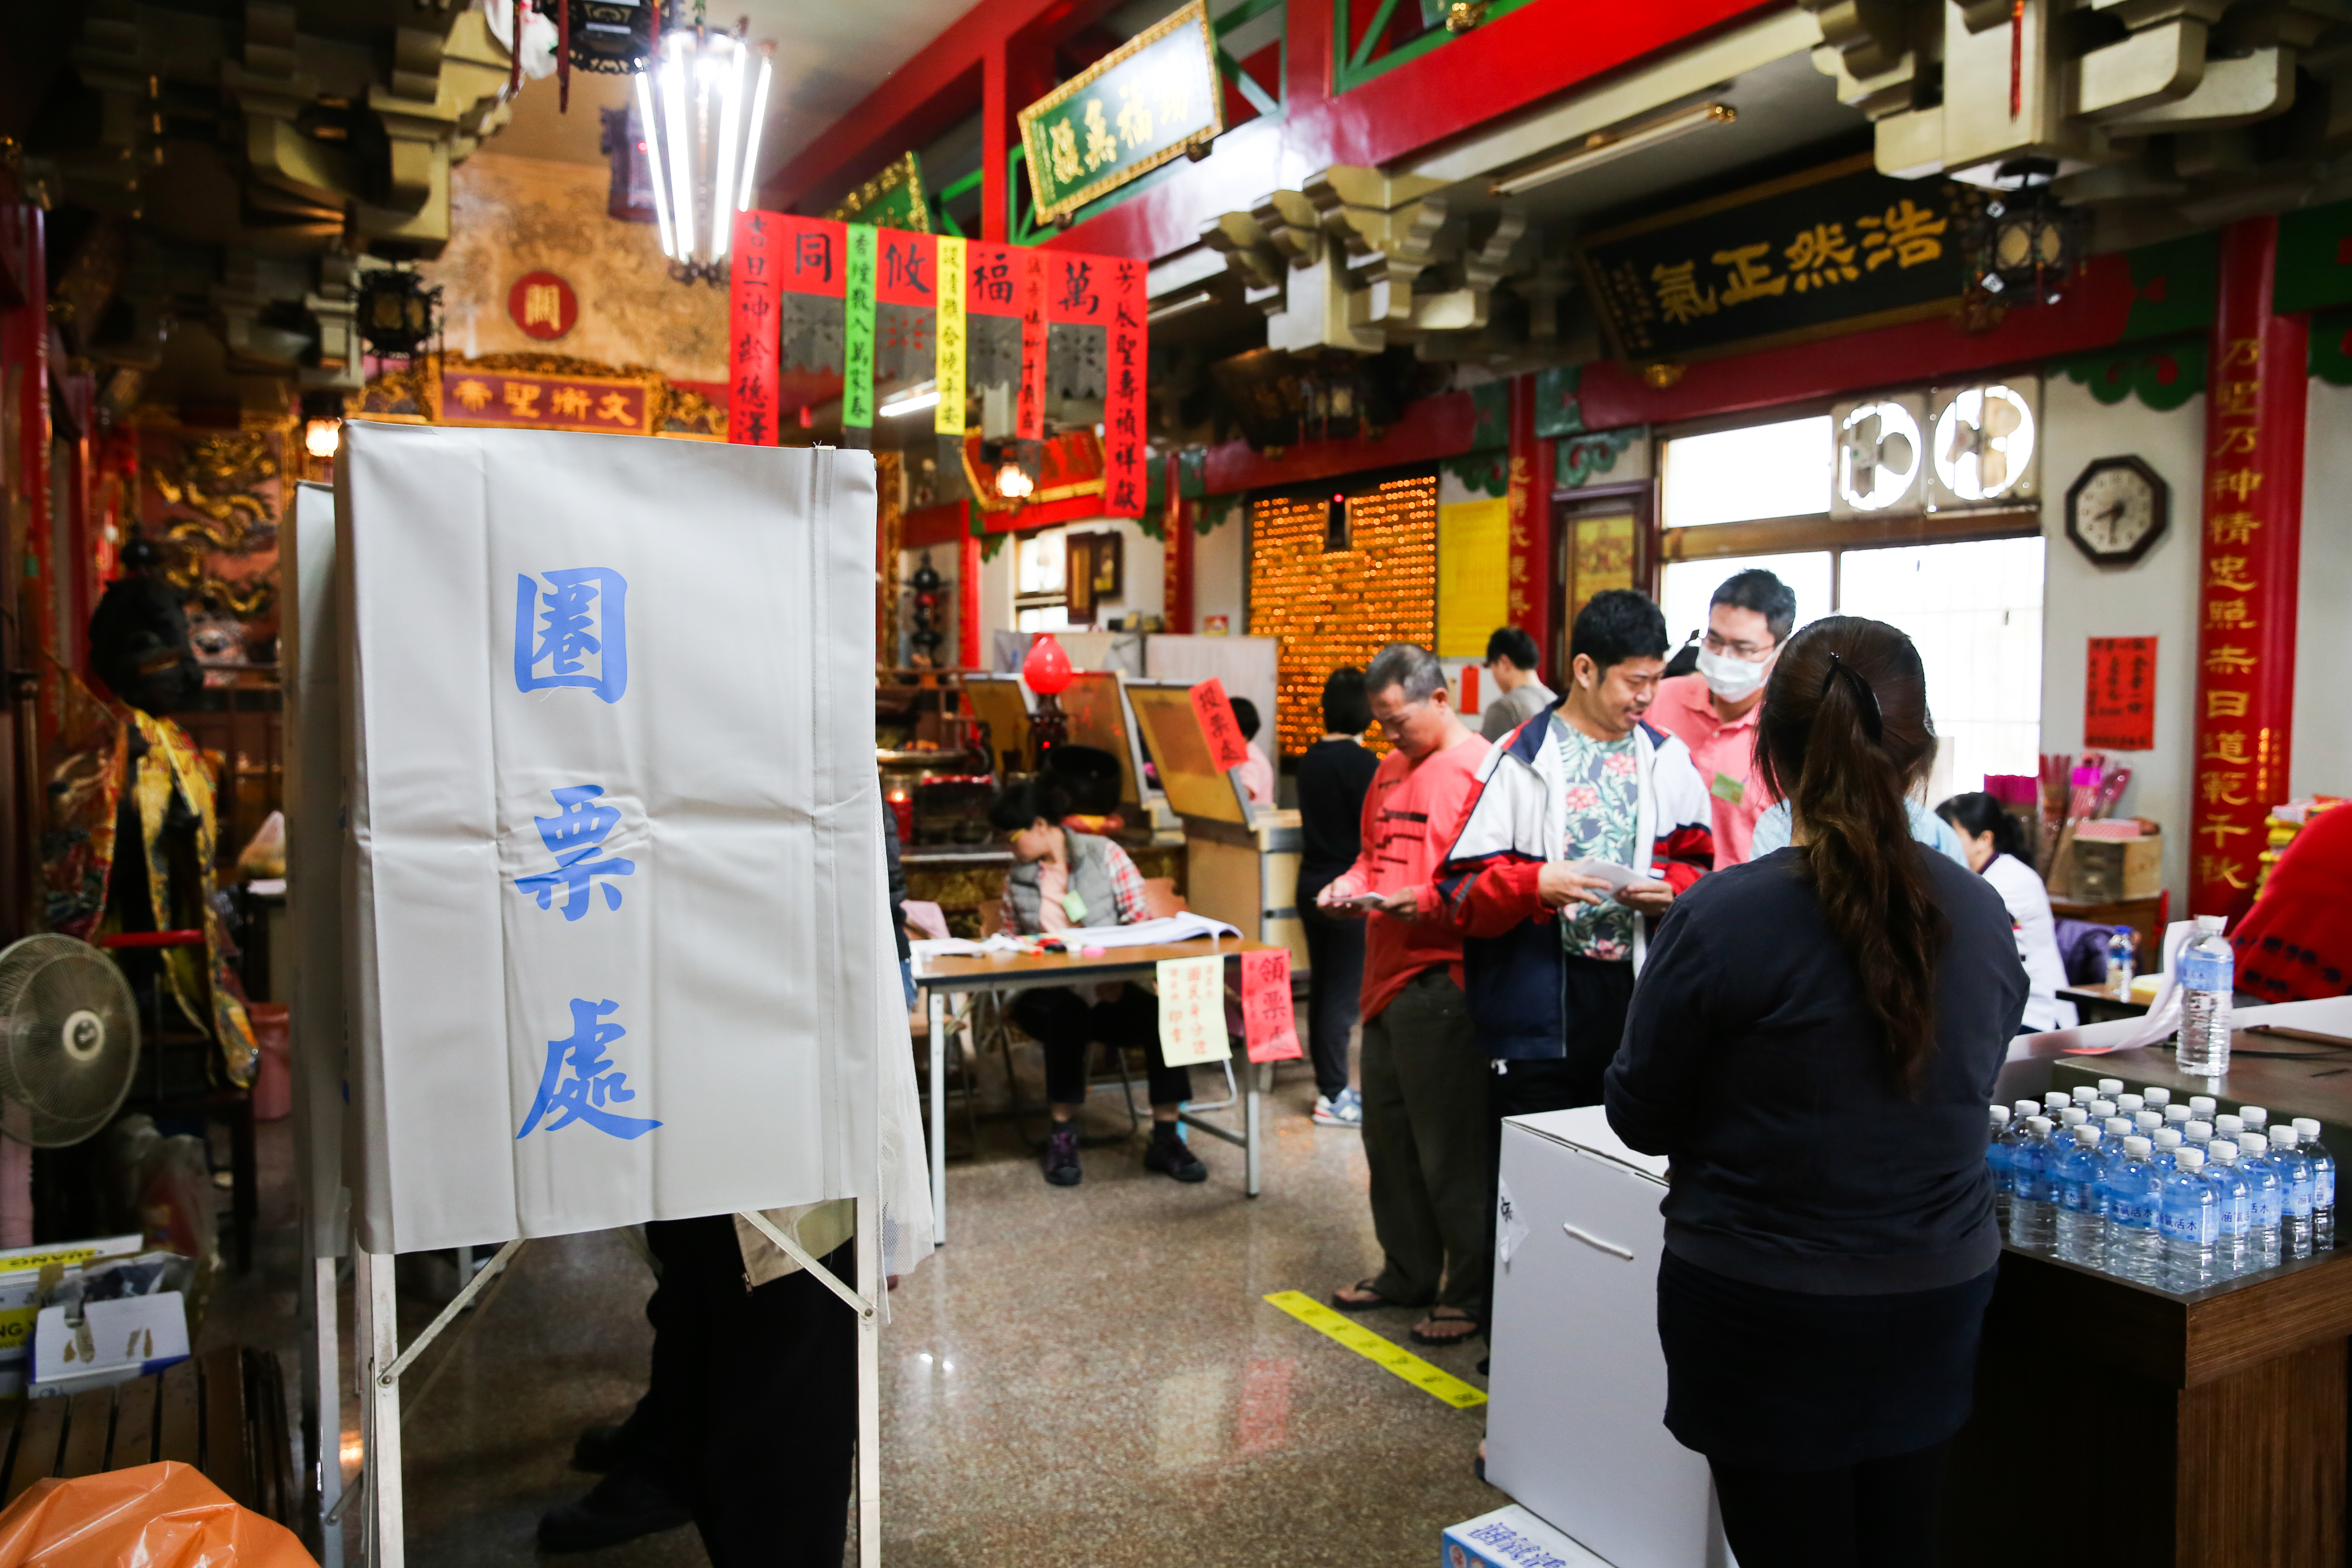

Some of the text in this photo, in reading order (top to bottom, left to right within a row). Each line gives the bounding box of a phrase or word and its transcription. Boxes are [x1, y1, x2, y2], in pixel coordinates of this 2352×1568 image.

[1650, 198, 1947, 325] 浩然正氣
[514, 567, 663, 1140] 圈票處
